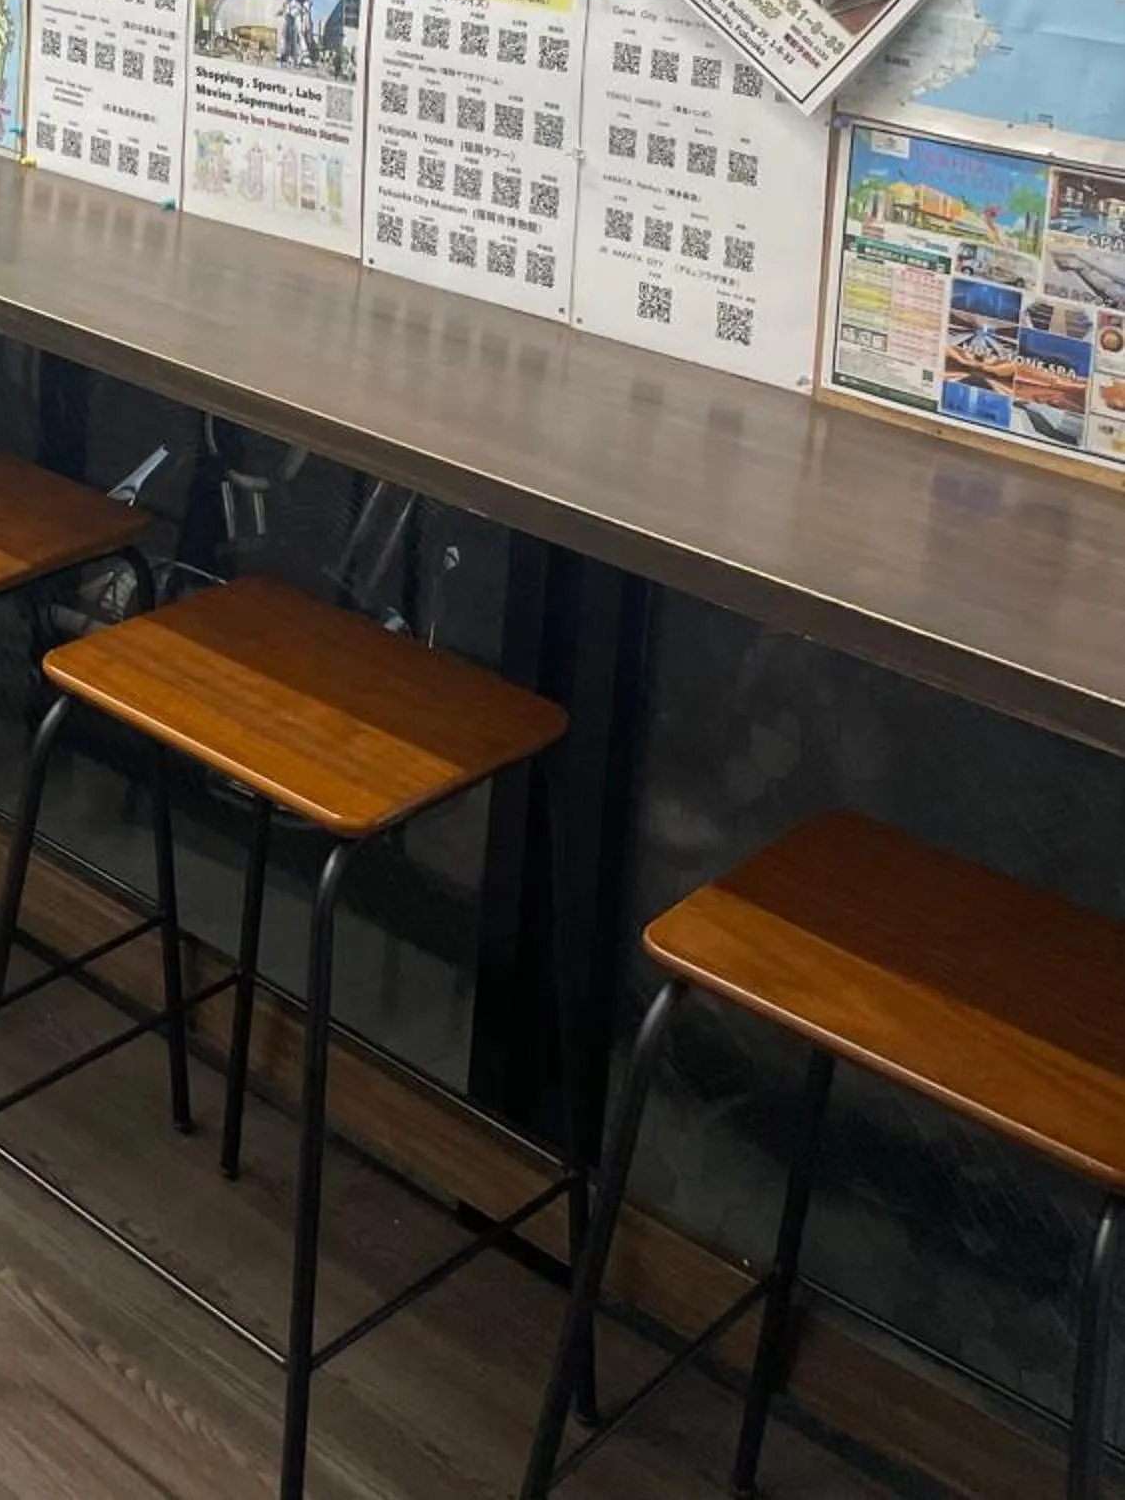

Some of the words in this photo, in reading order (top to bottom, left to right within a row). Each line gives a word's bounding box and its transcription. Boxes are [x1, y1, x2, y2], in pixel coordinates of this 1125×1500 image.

[196, 65, 244, 88] Shopping
[252, 77, 286, 95] Sports
[296, 86, 322, 102] Labo
[196, 83, 232, 102] Movies
